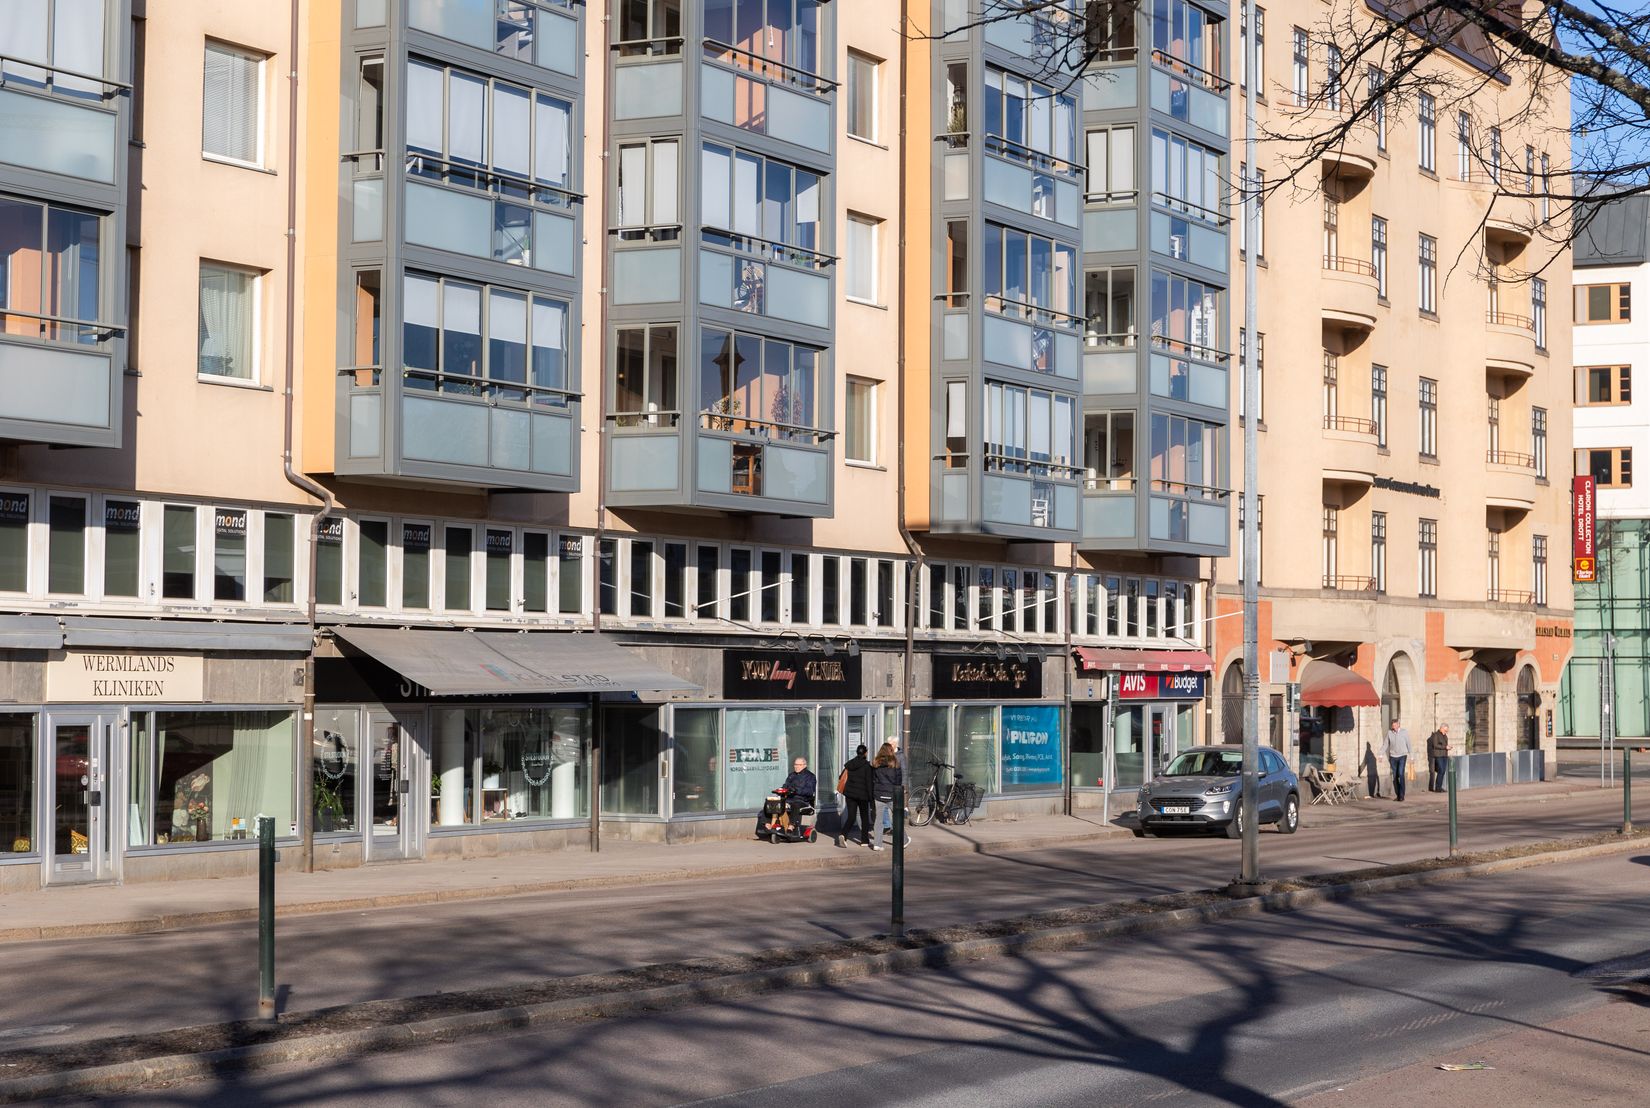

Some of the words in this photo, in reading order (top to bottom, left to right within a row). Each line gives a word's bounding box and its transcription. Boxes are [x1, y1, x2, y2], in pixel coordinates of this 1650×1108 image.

[106, 505, 140, 520] mond
[216, 513, 246, 528] mond
[404, 528, 430, 541] mond
[486, 533, 511, 546] mond
[560, 538, 582, 552] mond
[83, 656, 174, 672] WERMLANDS
[93, 680, 164, 696] KLINIKEN
[1123, 672, 1146, 692] AVIS
[1174, 675, 1198, 694] Budget
